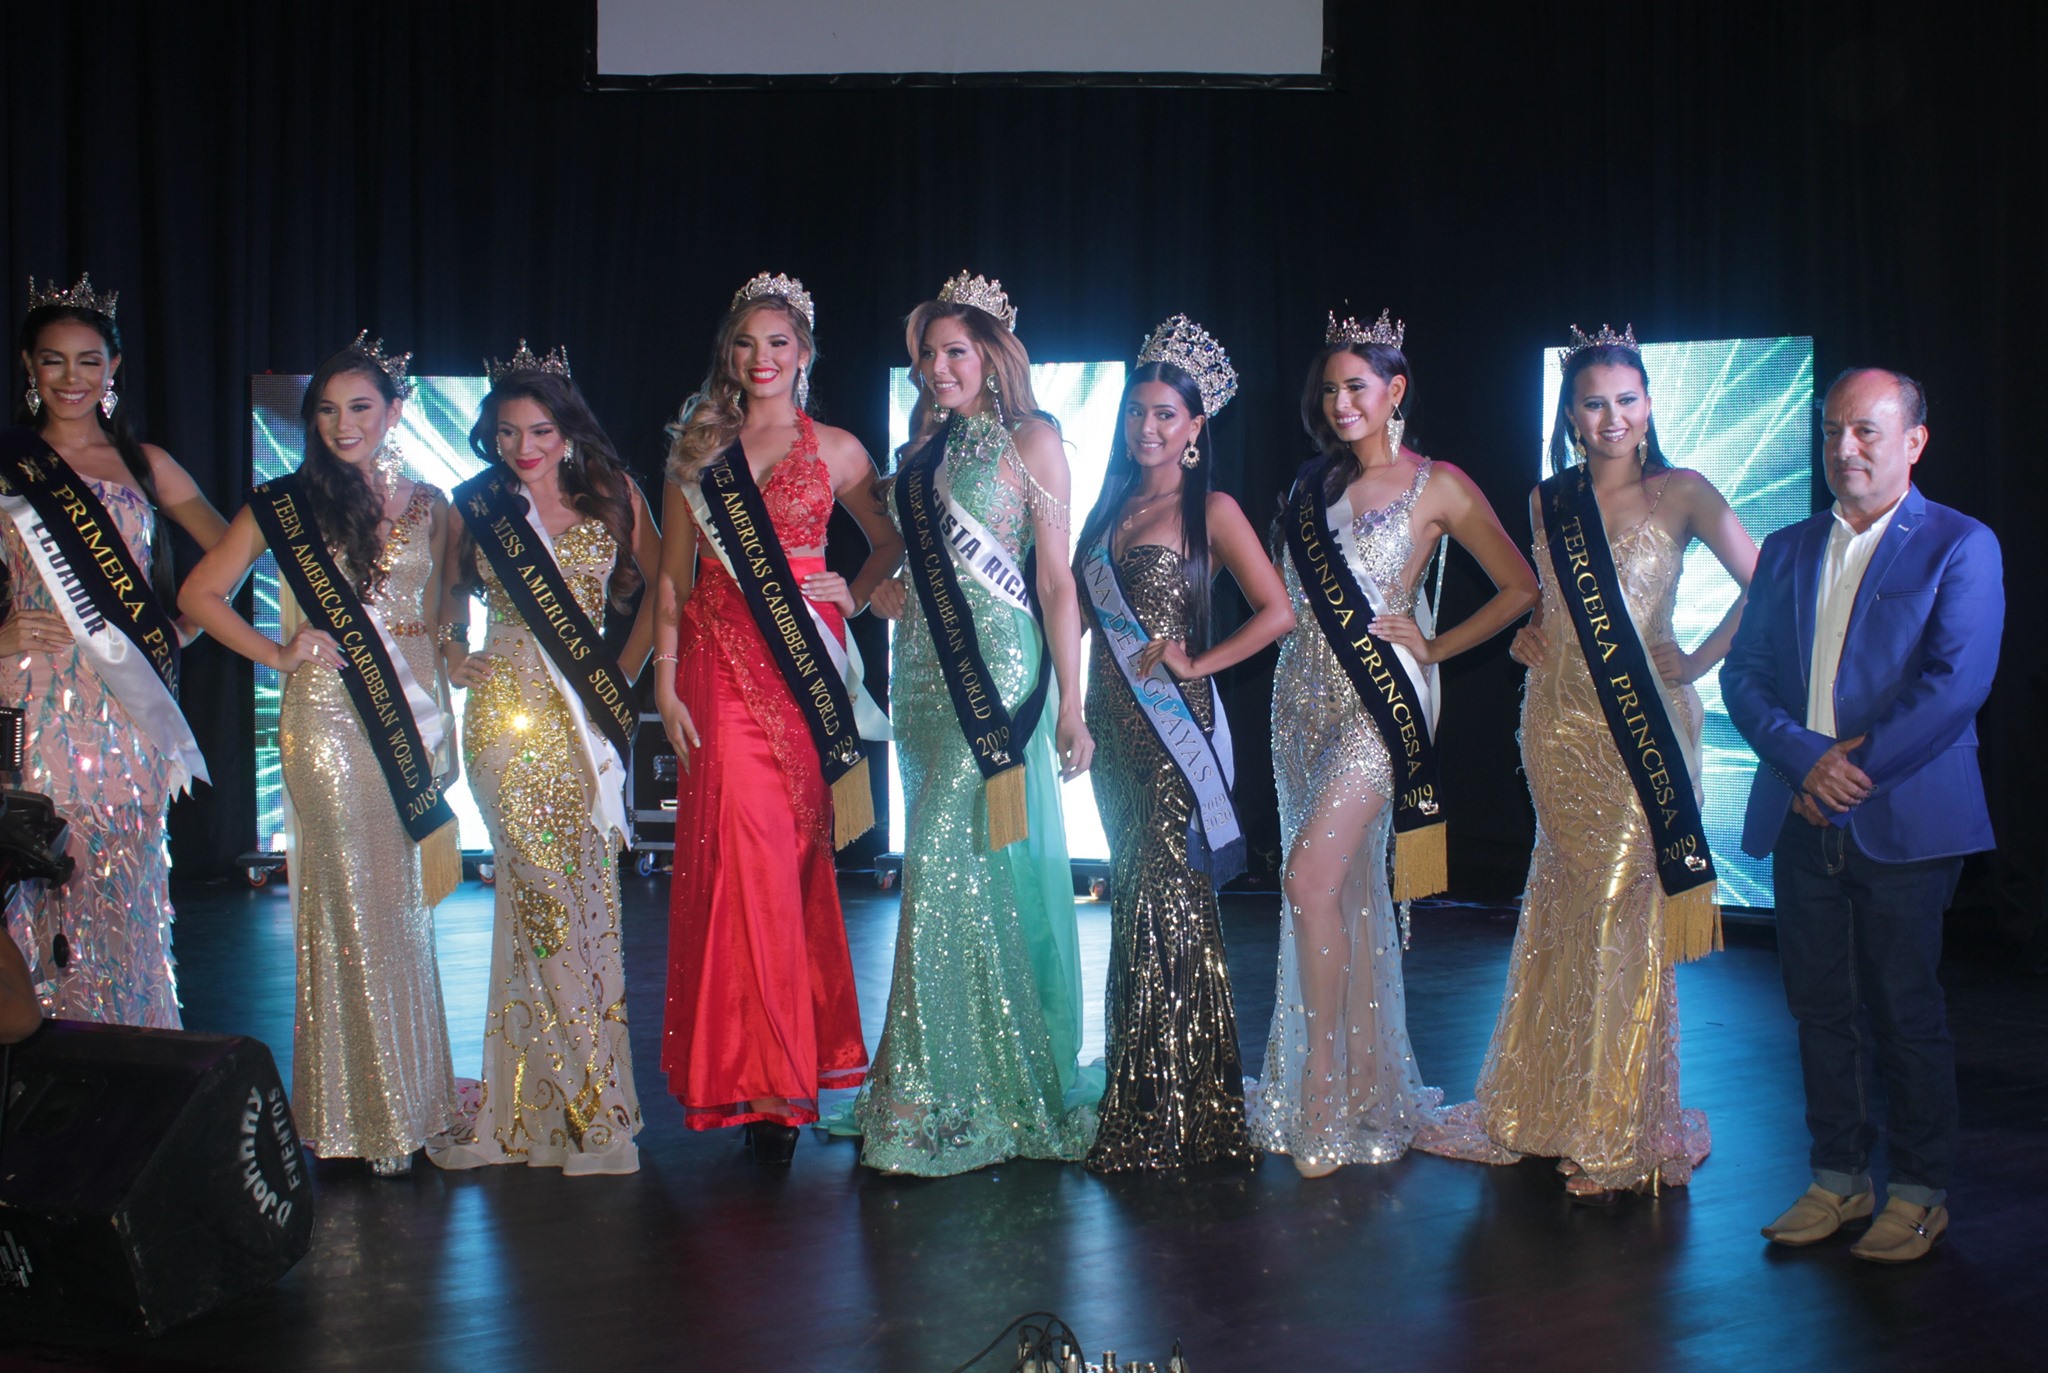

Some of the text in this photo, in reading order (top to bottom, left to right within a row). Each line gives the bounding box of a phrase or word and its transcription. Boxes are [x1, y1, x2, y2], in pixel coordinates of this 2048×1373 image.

[30, 521, 108, 638] ECUADOR
[52, 484, 145, 623] PRIMERA
[490, 515, 526, 559] MISS
[517, 564, 592, 661] AMERICAS
[908, 469, 992, 720] AMERICAS CARIBBEAN WORLD
[981, 555, 1029, 607] RICA
[272, 493, 421, 790] TEEN AMERICAS CARIBBEAN WORLD
[721, 492, 773, 578] AMERICAS
[761, 580, 819, 678] CARIBBEAN
[808, 677, 841, 736] WORLD
[1087, 553, 1213, 786] INA DEL GUAYAS
[1299, 493, 1422, 779] SEGUNDA PRINCESA
[1561, 517, 1681, 830] TERCERA PRINCESA
[826, 735, 853, 767] 2019
[976, 726, 1009, 757] 2019
[1399, 783, 1434, 811] 2019
[406, 787, 437, 821] 2019
[1201, 793, 1226, 815] 2019
[1204, 808, 1232, 832] 2020
[1662, 833, 1697, 866] 2019
[267, 1086, 301, 1191] EVENTOS
